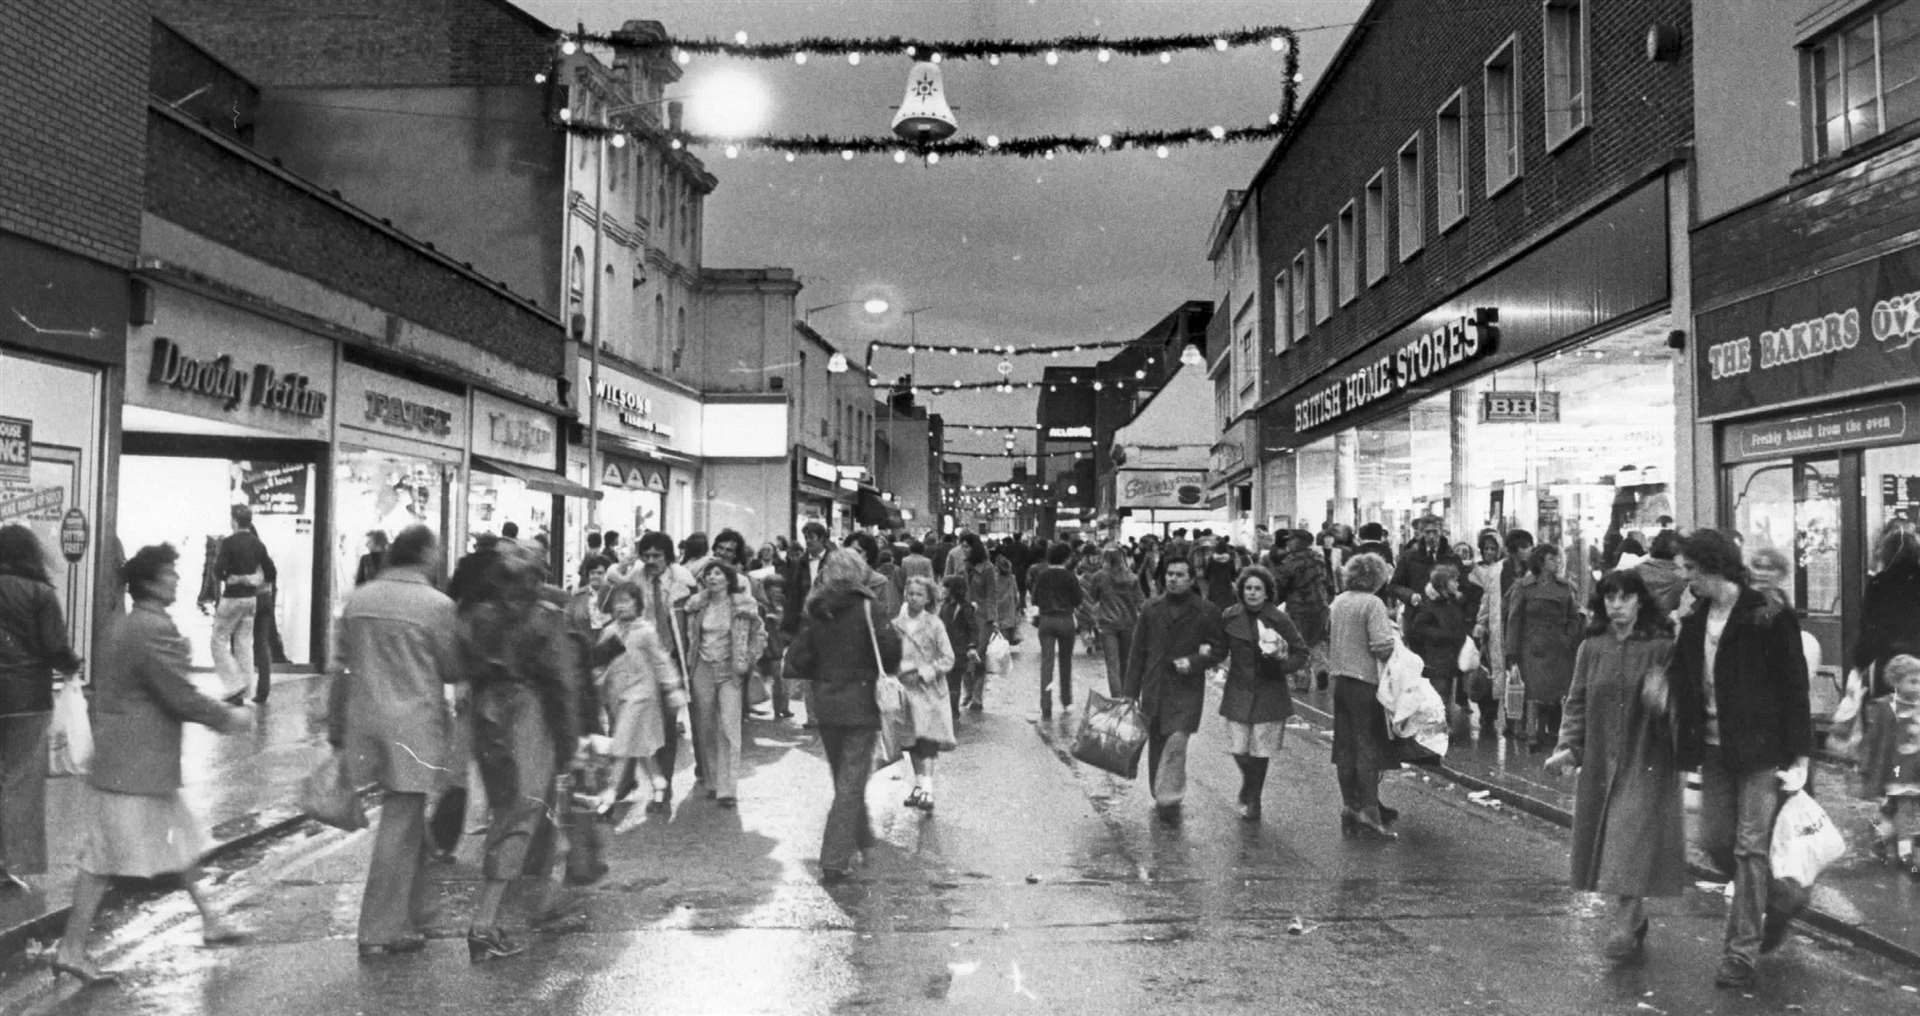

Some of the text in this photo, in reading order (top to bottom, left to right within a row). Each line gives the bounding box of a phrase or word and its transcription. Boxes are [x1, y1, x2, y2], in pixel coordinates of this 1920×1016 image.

[151, 338, 327, 417] Dorothy Perkins
[1295, 314, 1481, 433] BRITISH HOME STORES
[1708, 336, 1751, 380] THE
[1760, 307, 1860, 369] BAKERS
[1489, 399, 1553, 414] BHS
[1751, 431, 1782, 447] Freshly
[1817, 423, 1840, 438] from
[1846, 419, 1861, 433] the
[1865, 416, 1890, 430] oven
